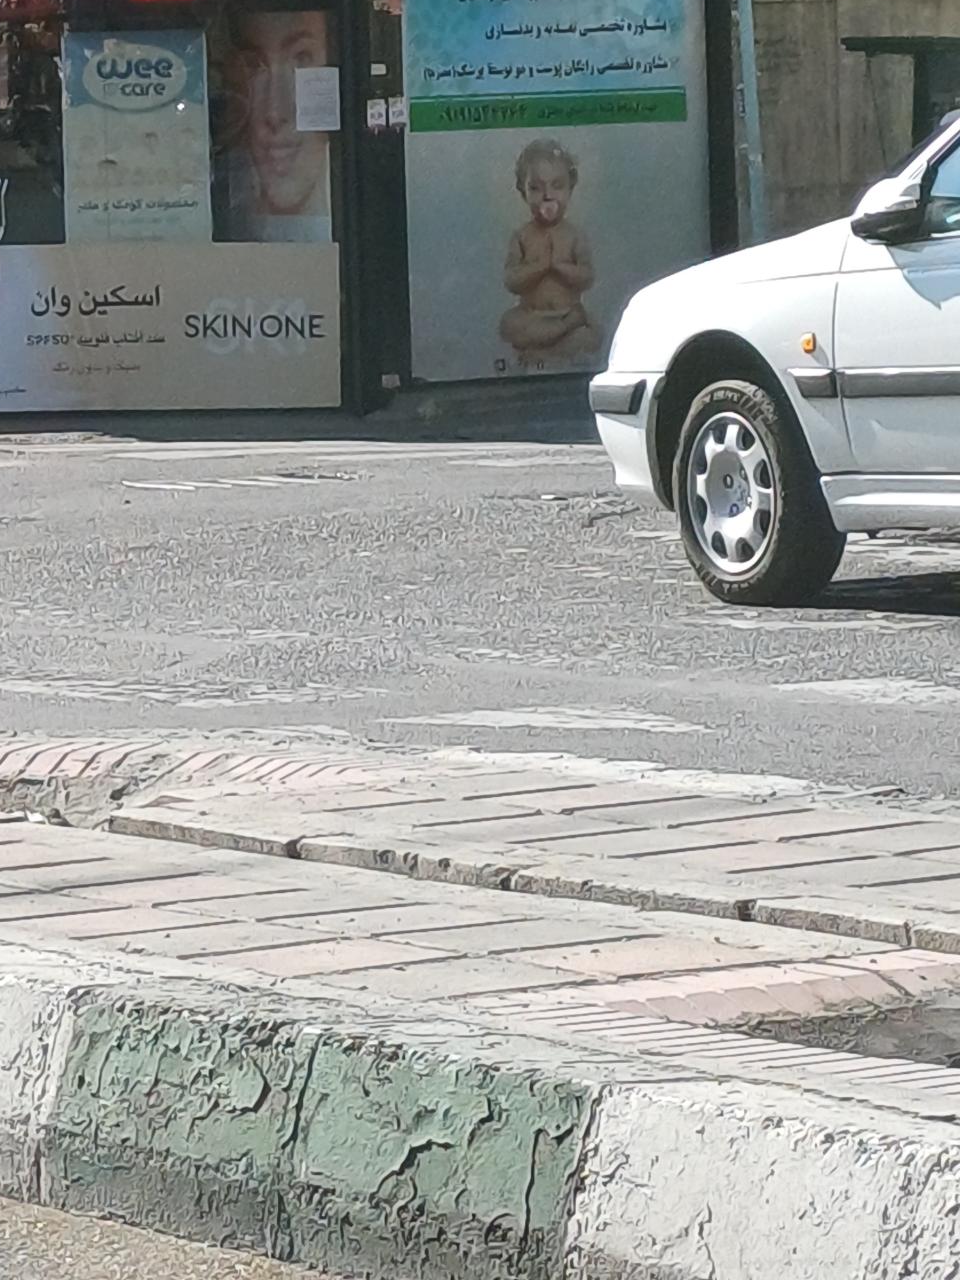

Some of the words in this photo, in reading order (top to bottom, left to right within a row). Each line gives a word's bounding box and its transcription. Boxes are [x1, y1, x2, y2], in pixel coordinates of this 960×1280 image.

[96, 57, 174, 80] wee
[120, 82, 166, 96] care
[31, 286, 71, 317] وان
[78, 285, 161, 317] اسکین
[184, 314, 253, 339] SKIN
[259, 315, 326, 339] ONE
